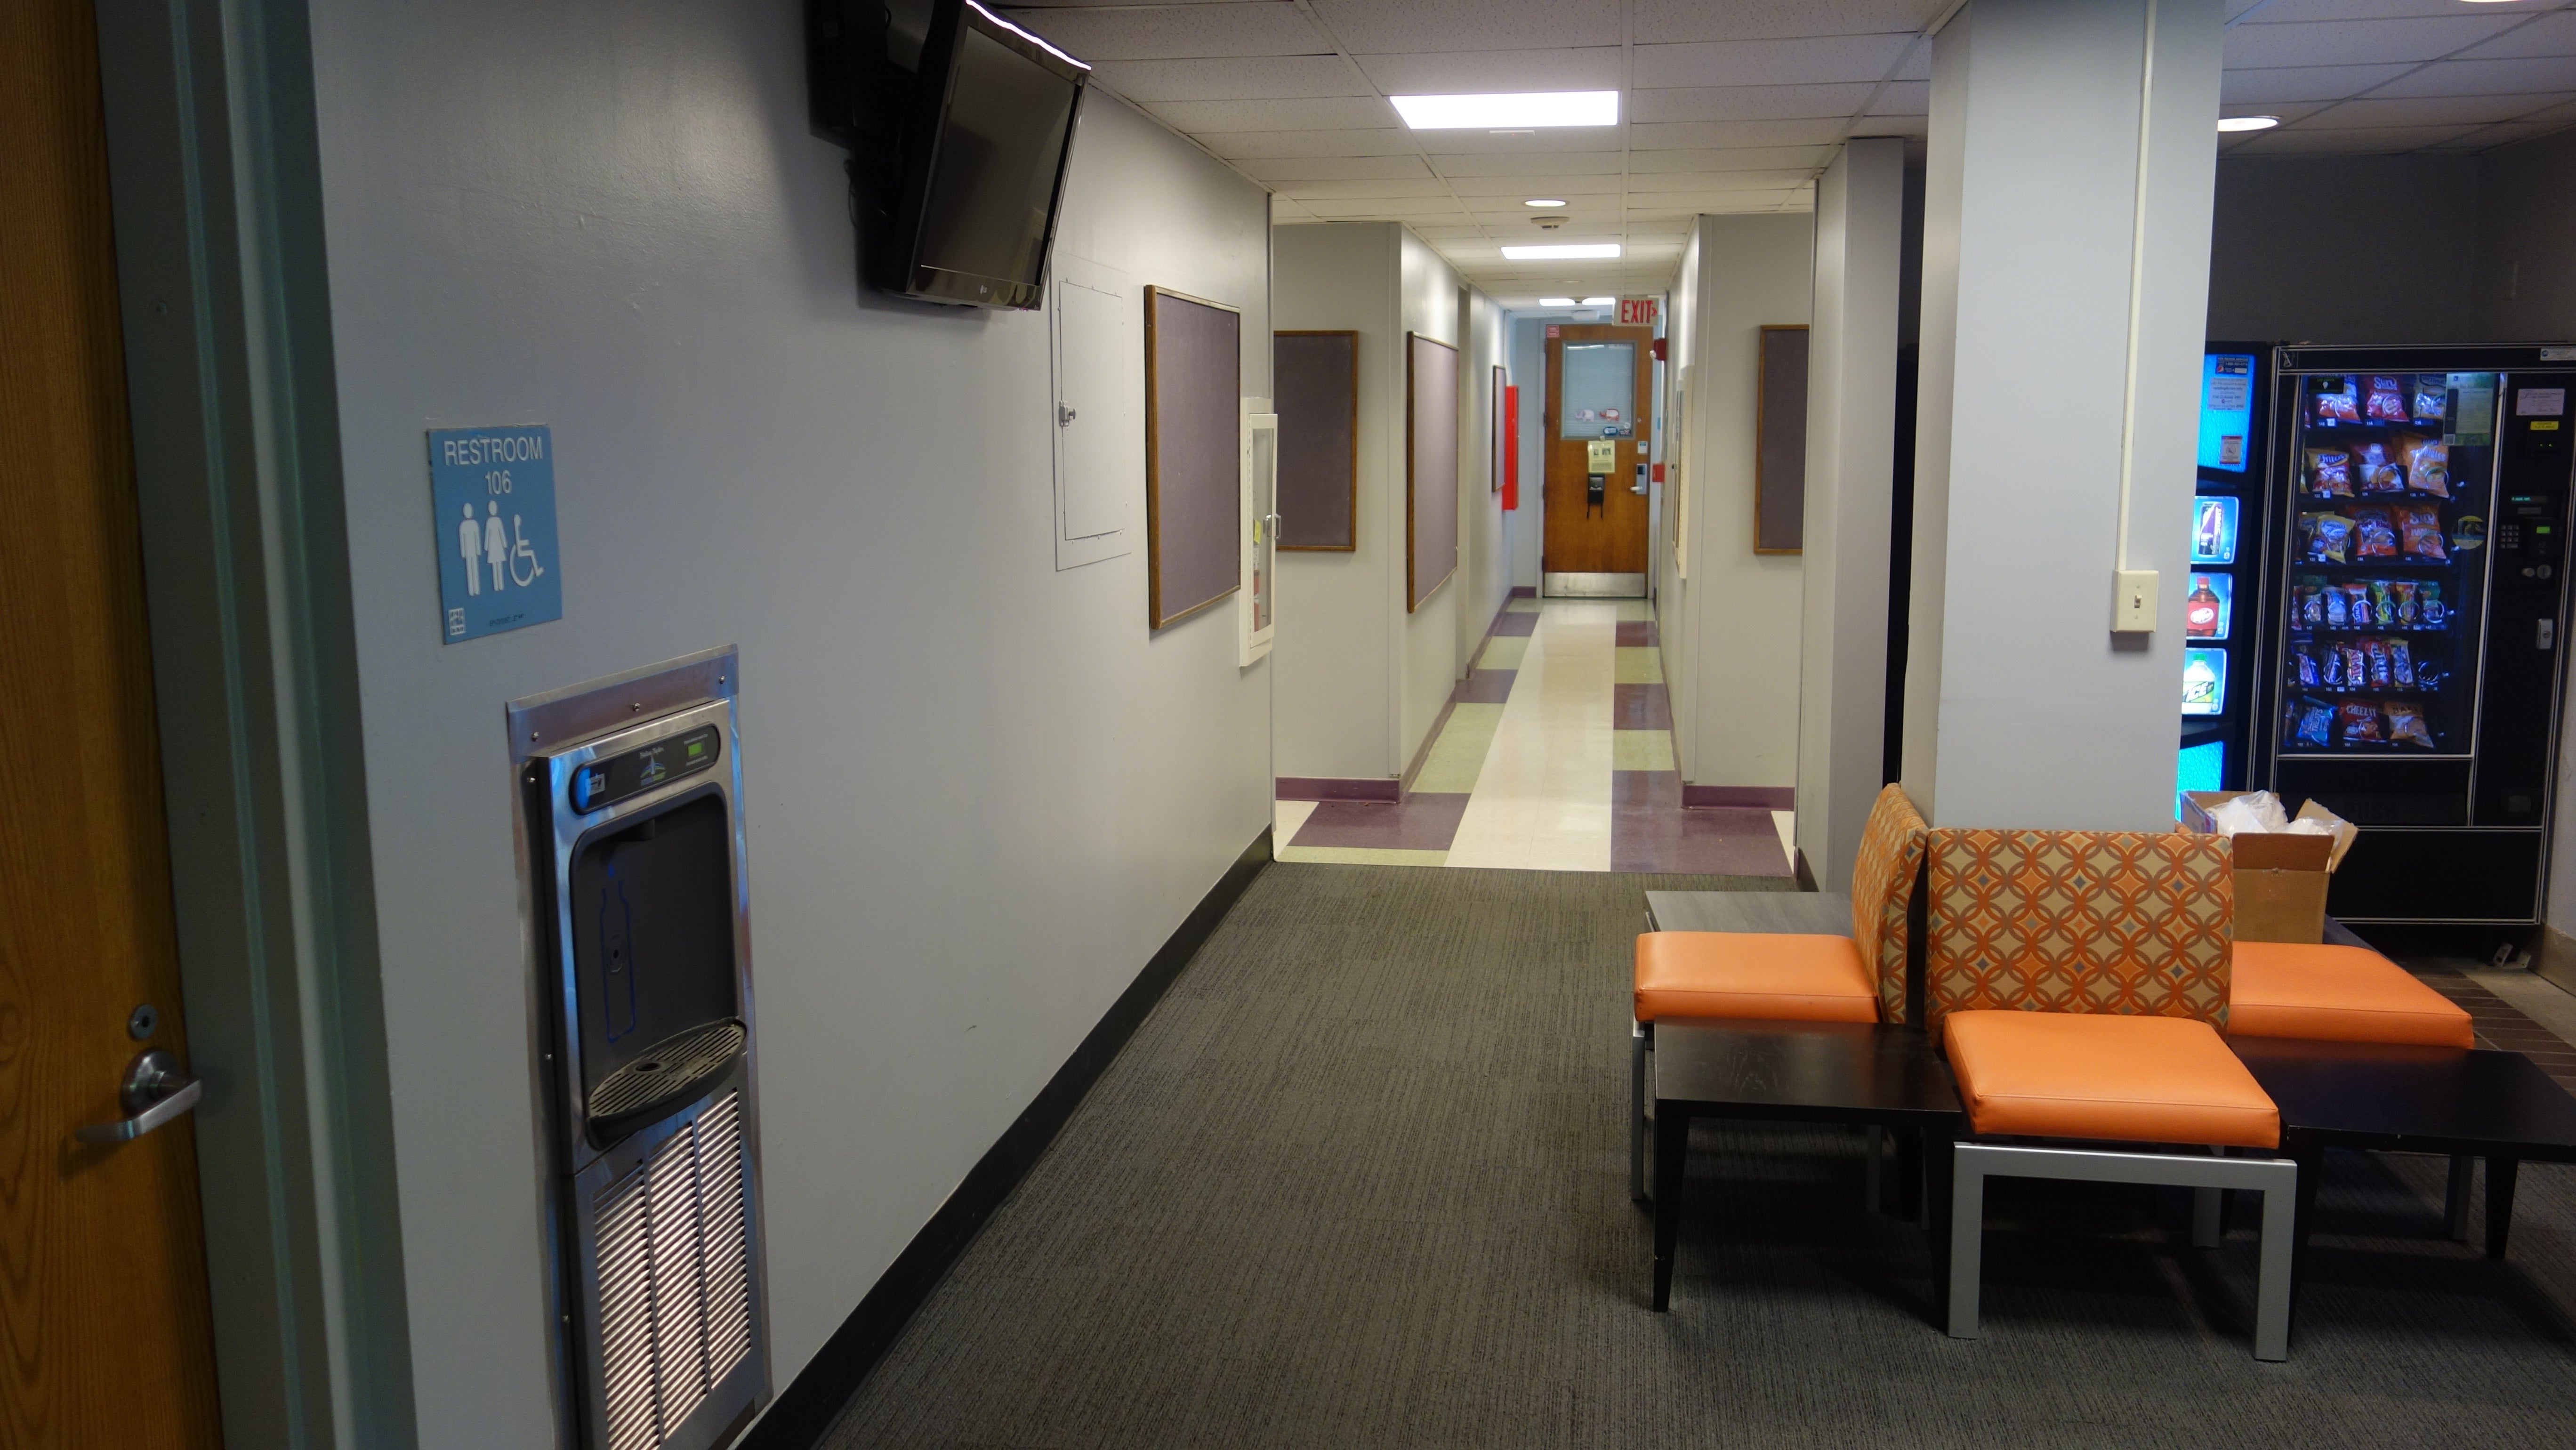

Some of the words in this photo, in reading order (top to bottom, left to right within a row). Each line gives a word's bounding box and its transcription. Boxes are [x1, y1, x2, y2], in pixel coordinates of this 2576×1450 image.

[1621, 299, 1653, 323] EXIT
[2374, 376, 2397, 389] Sun
[443, 436, 543, 466] RESTROOM
[2317, 453, 2345, 463] Fritos
[485, 470, 512, 495] 106
[2344, 800, 2397, 821] PUSH
